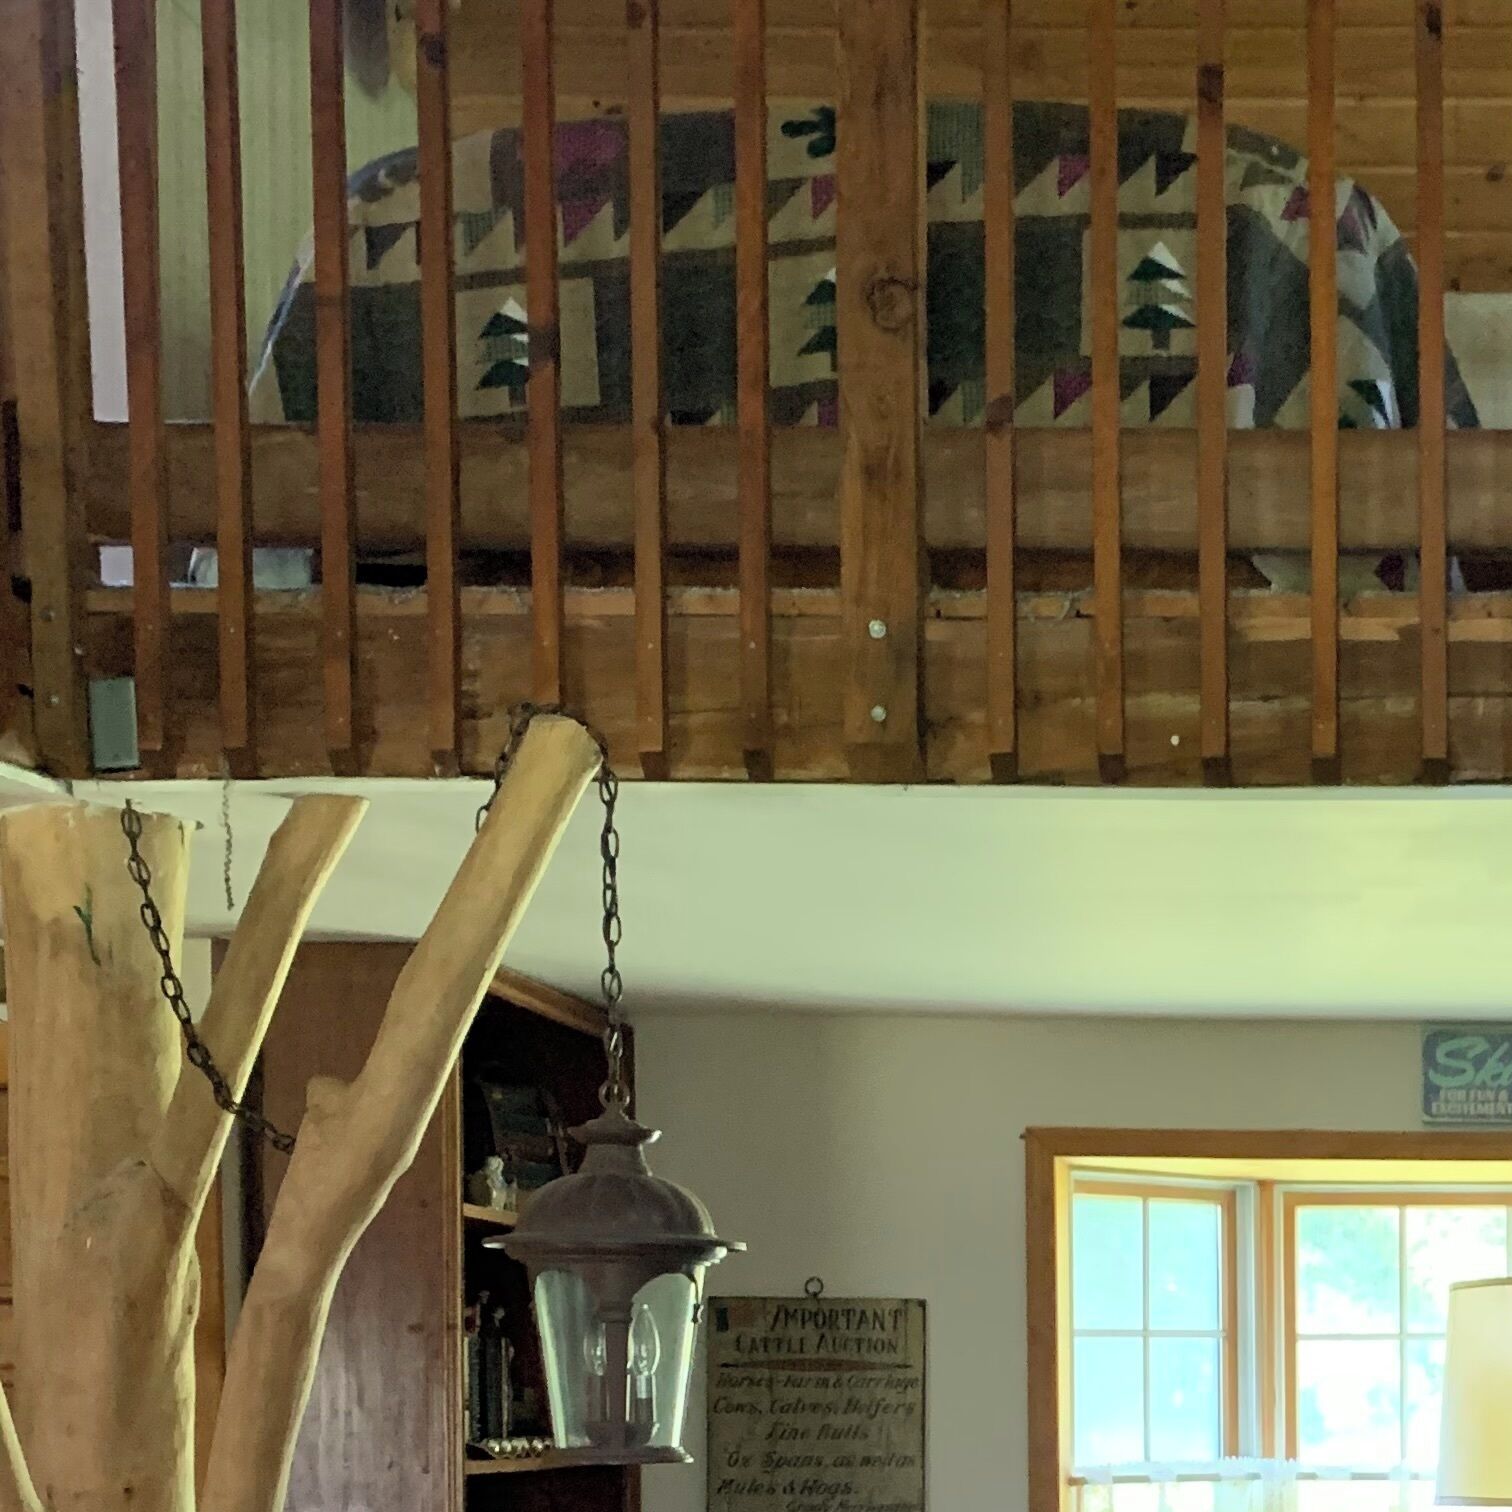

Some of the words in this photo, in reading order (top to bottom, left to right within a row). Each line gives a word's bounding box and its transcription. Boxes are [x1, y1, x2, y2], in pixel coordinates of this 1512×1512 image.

[769, 1304, 905, 1332] IMPORTANT
[735, 1333, 805, 1354] CATTLE
[815, 1332, 898, 1355] AUCTION
